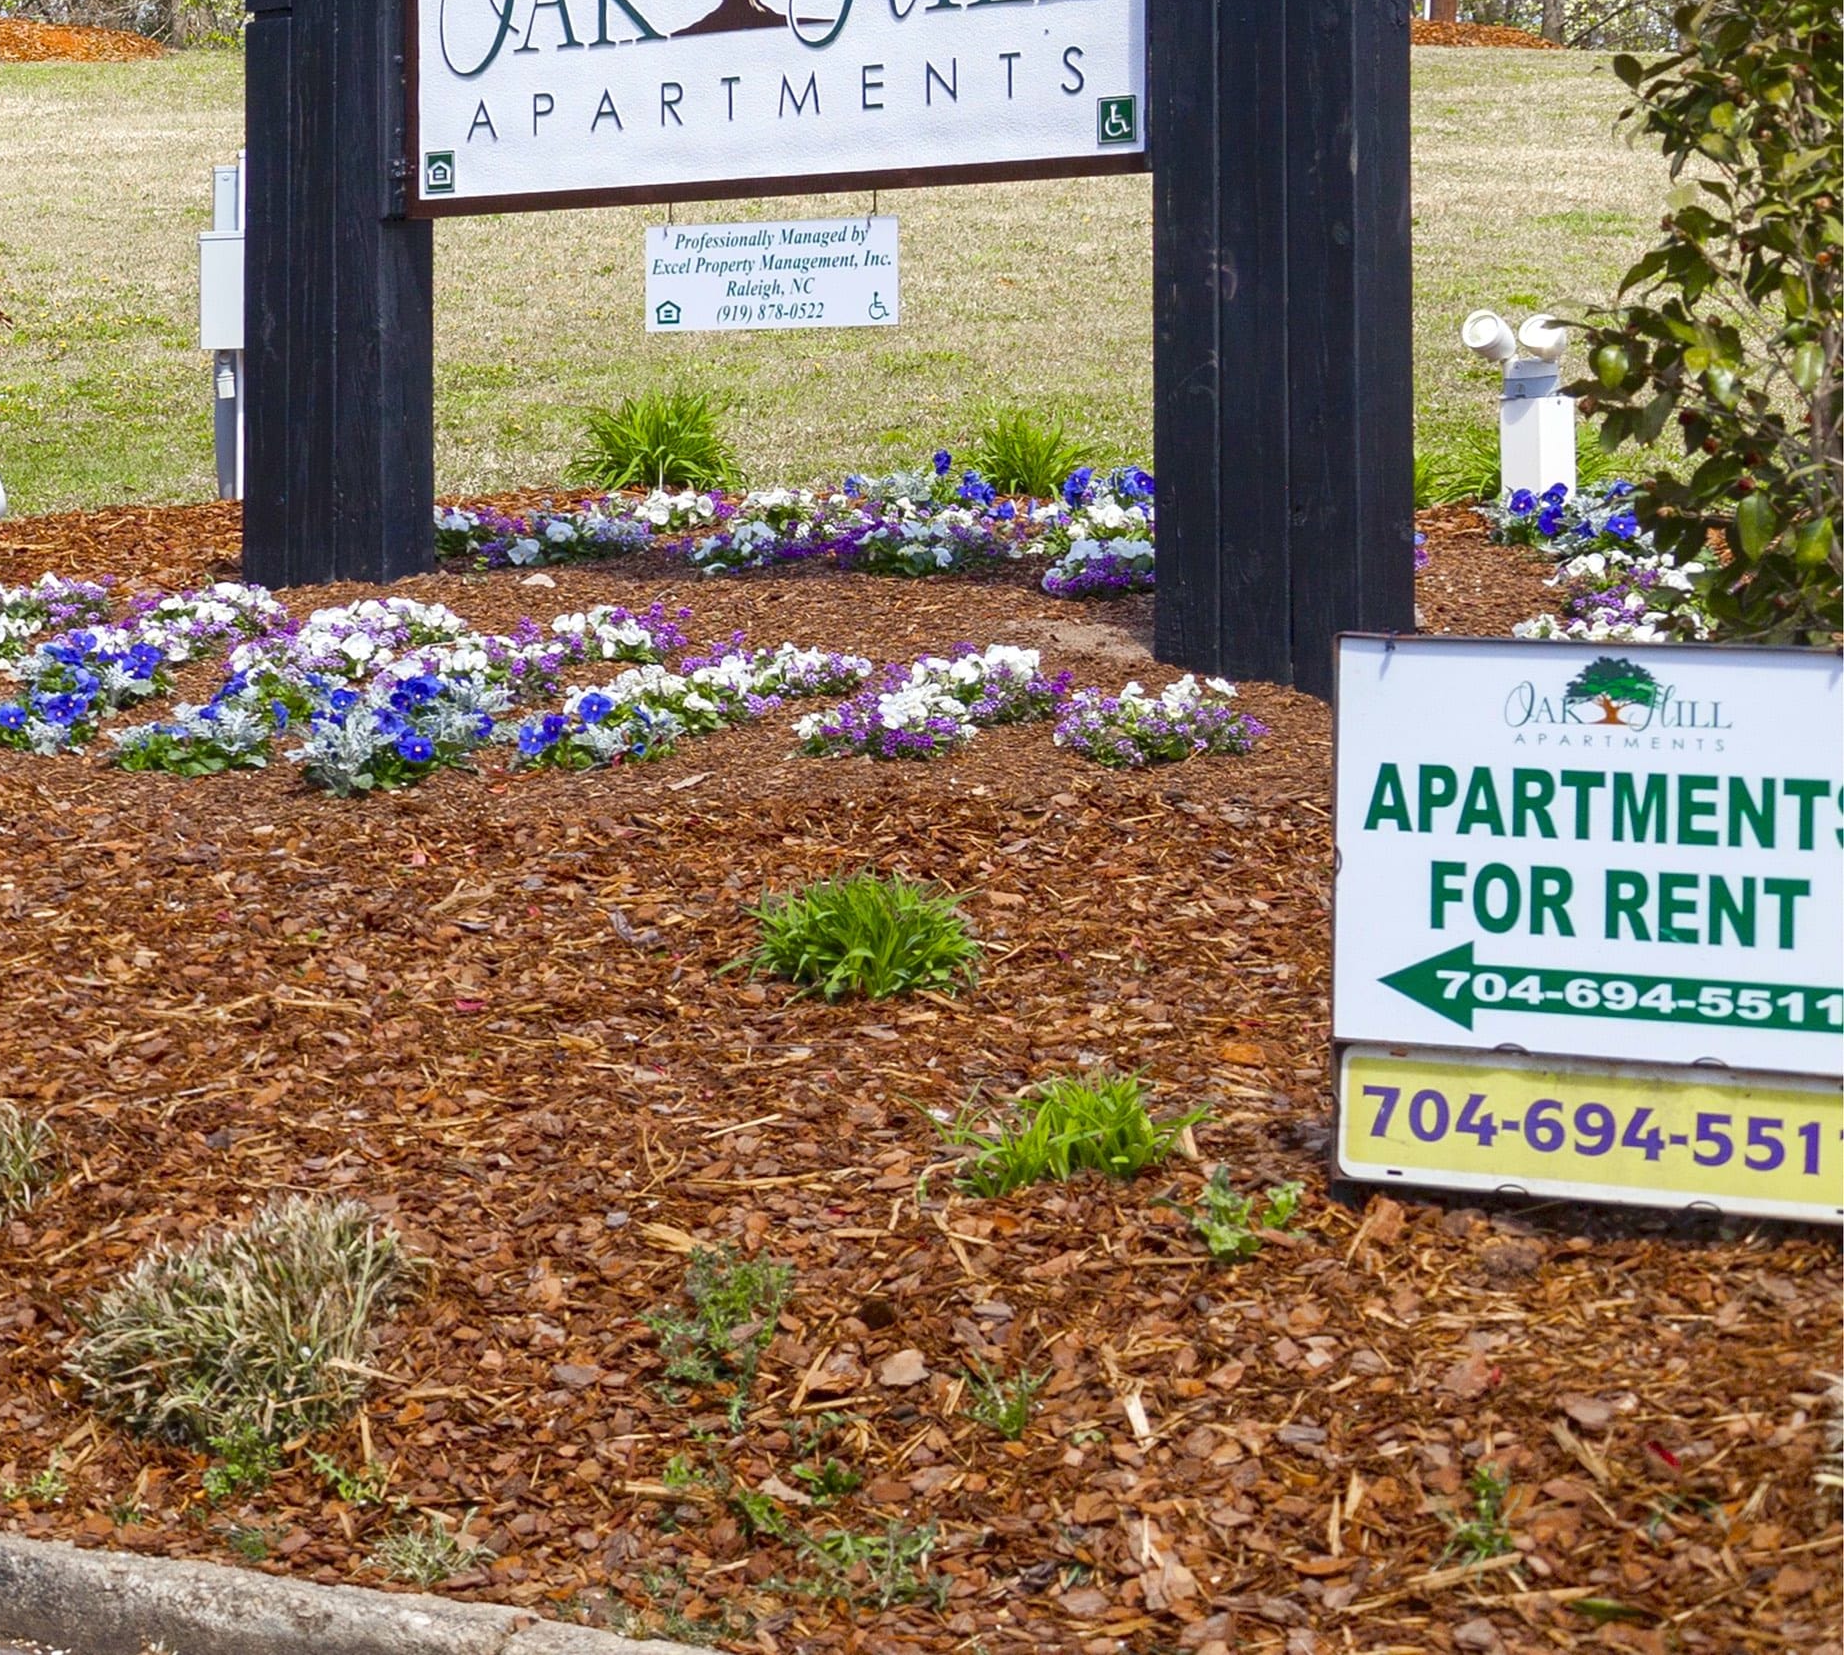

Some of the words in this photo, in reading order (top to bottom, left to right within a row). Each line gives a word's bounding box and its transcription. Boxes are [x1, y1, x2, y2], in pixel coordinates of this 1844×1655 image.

[466, 45, 1086, 143] APARTMENTS
[652, 258, 690, 275] Excel
[695, 256, 755, 277] Property
[759, 253, 858, 273] Management,
[863, 250, 892, 267] Inc.
[675, 230, 775, 253] Professionally
[779, 226, 847, 248] Managed
[851, 225, 869, 246] by
[716, 305, 753, 325] (919)
[757, 302, 825, 321] 878-0522
[726, 279, 785, 299] Raleigh,
[790, 277, 815, 295] NC
[1504, 680, 1586, 728] OAK
[1627, 682, 1733, 732] HILL
[1514, 732, 1725, 752] APARTMENTS
[1363, 762, 1844, 852] APARTMENT
[1429, 859, 1576, 938] FOR
[1604, 868, 1811, 951] RENT
[1436, 969, 1843, 1027] 704-694-5511
[1362, 1084, 1843, 1176] 704-694-551
